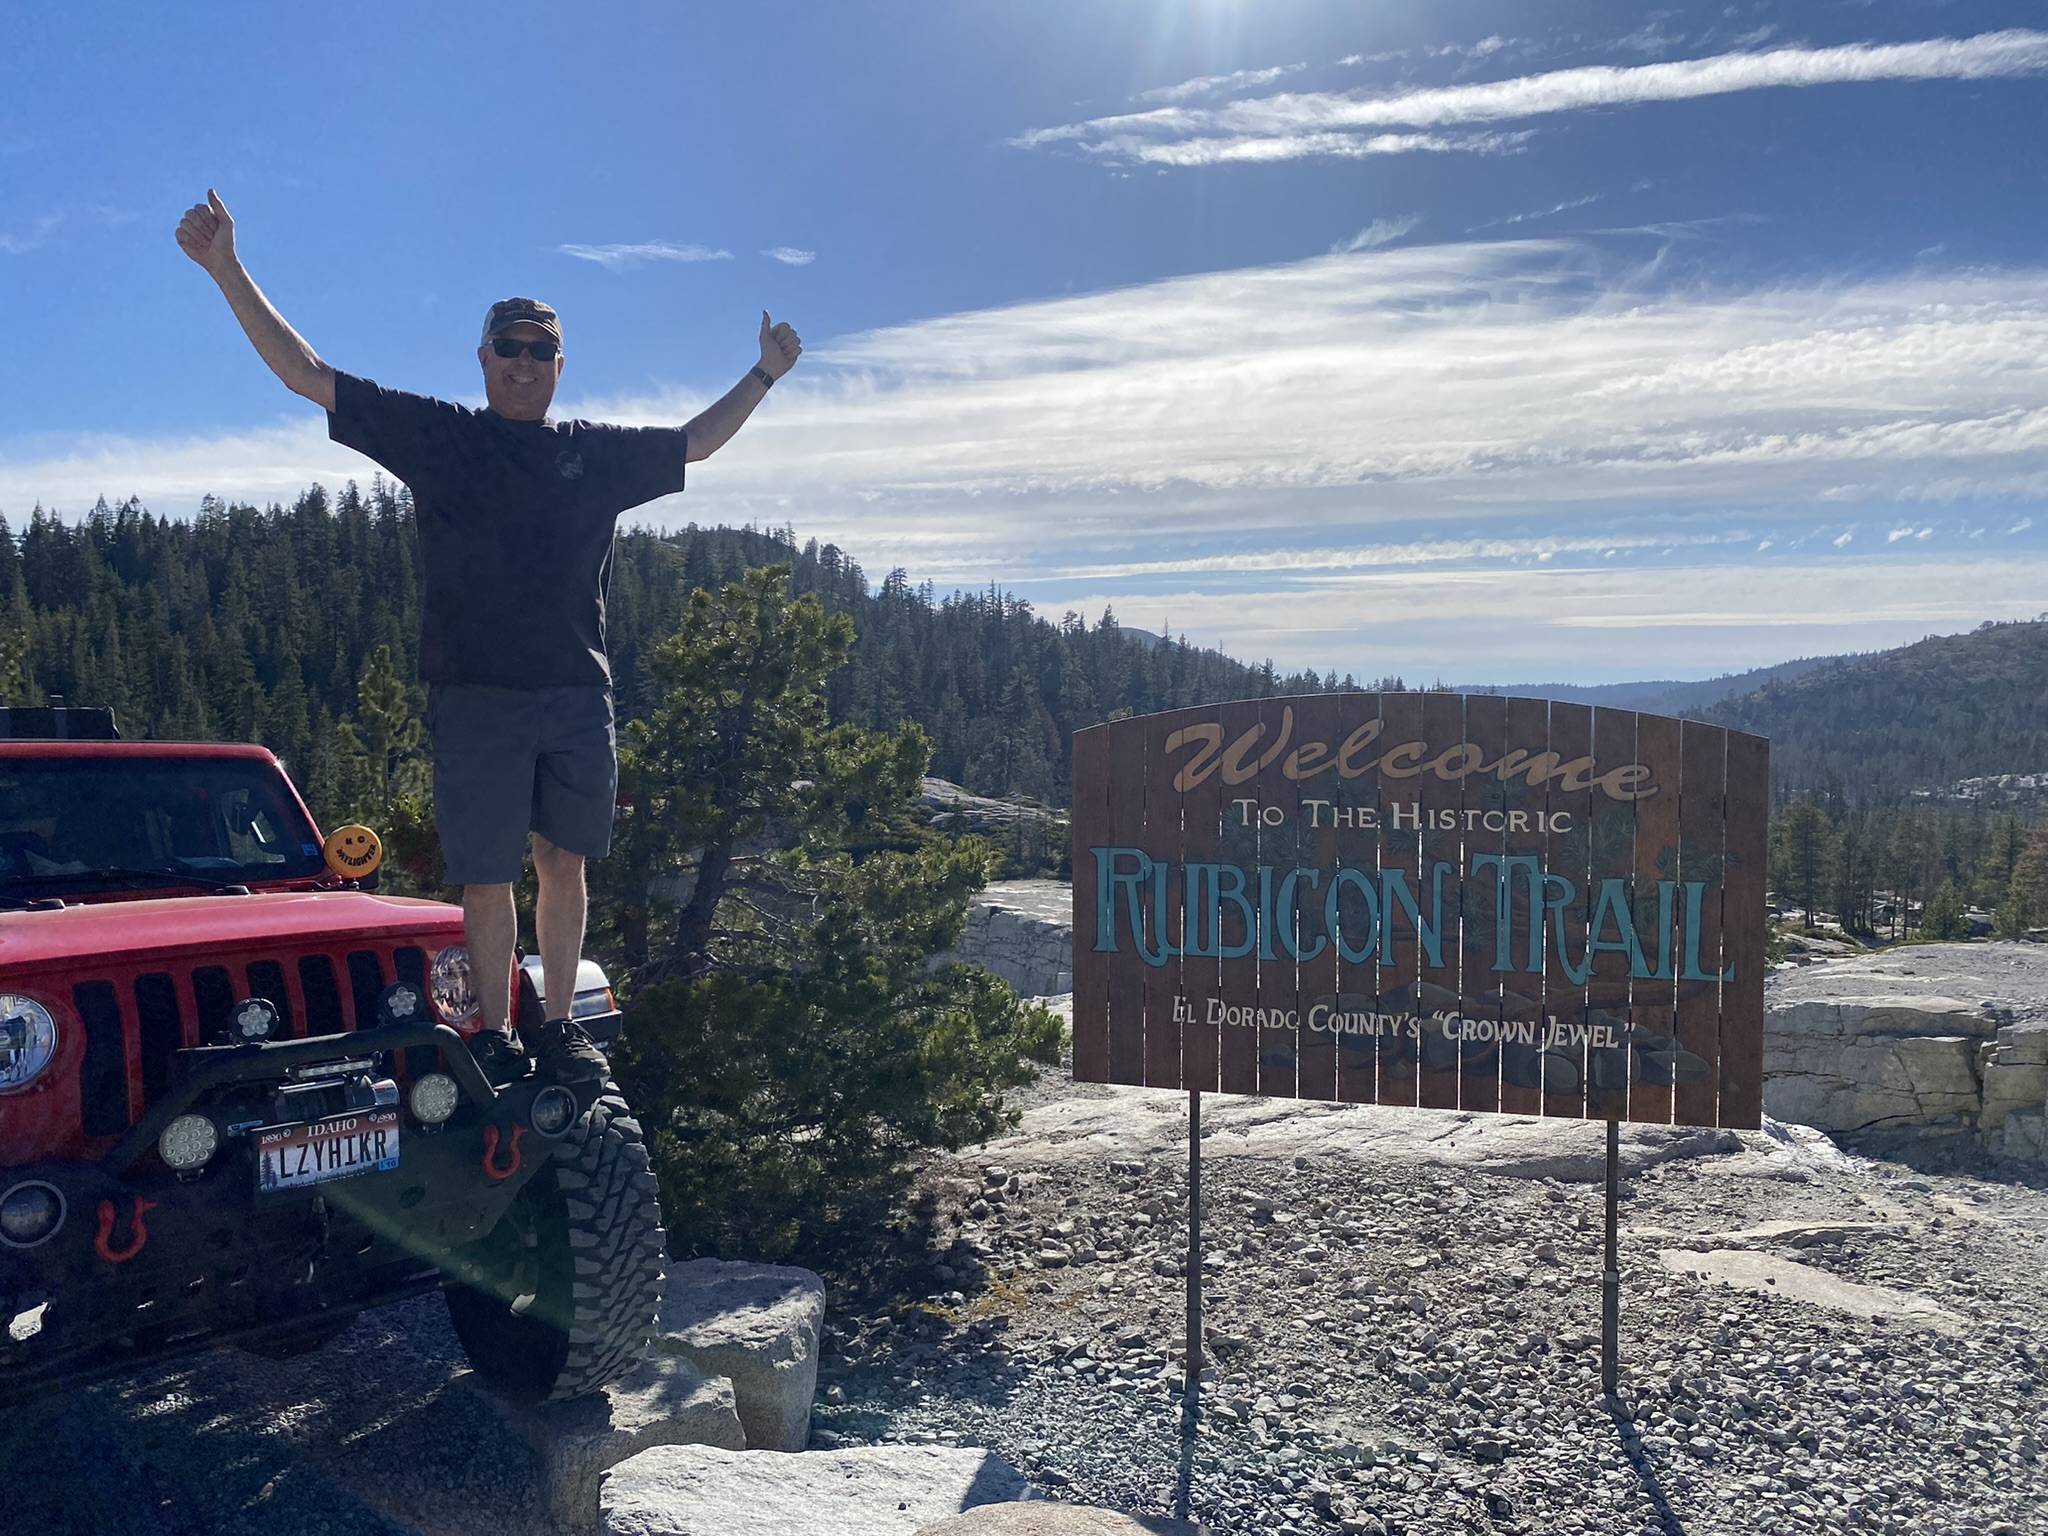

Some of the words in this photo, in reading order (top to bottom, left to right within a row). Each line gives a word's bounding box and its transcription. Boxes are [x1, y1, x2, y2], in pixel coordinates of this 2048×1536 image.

[1165, 705, 1660, 801] Welcome
[1089, 847, 1452, 969] RUBICON
[1471, 853, 1736, 986] TRAIL
[261, 1133, 283, 1145] 1890
[307, 1118, 358, 1138] IDAHO
[376, 1112, 398, 1124] 1990
[280, 1129, 387, 1179] LZYHIKR
